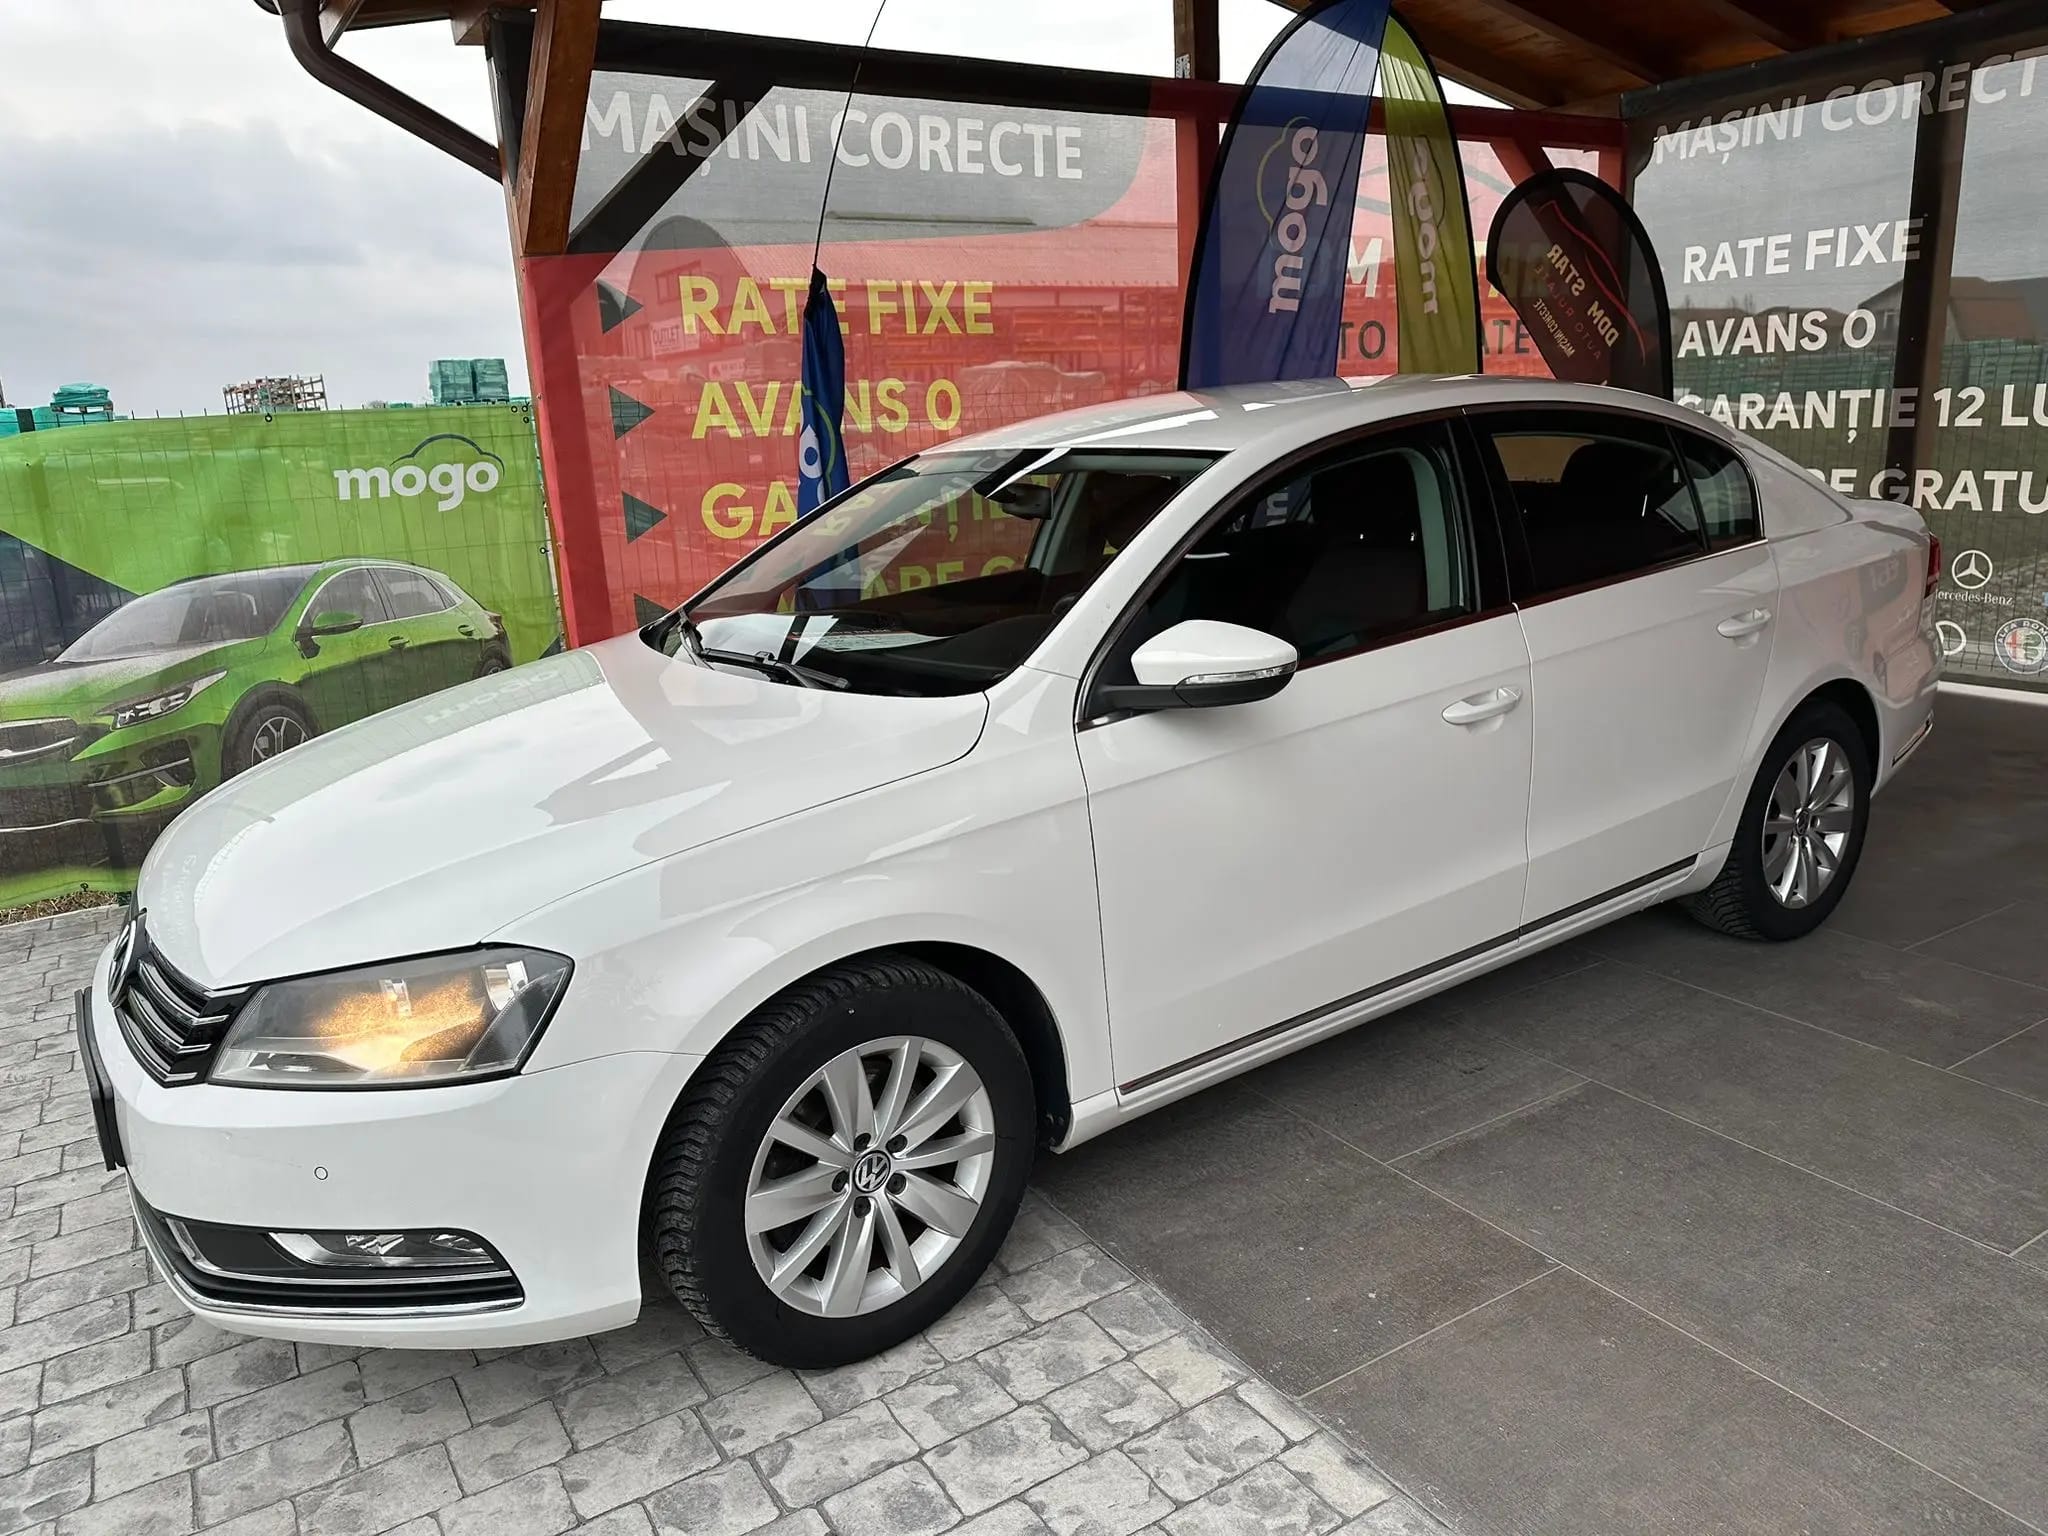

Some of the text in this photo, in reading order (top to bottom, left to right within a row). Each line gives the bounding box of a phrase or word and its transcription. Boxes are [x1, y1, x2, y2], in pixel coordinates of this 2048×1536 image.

[830, 108, 1083, 179] CORECTE
[1268, 126, 1328, 314] mogo
[1682, 218, 1924, 284] RATE FIXE
[868, 279, 994, 335] FIXE
[1677, 309, 1829, 359] AVANS
[1933, 386, 1986, 427] 12
[333, 462, 500, 511] mogo
[1936, 589, 2014, 606] ercedes-Benz
[1997, 621, 2018, 643] ALFA
